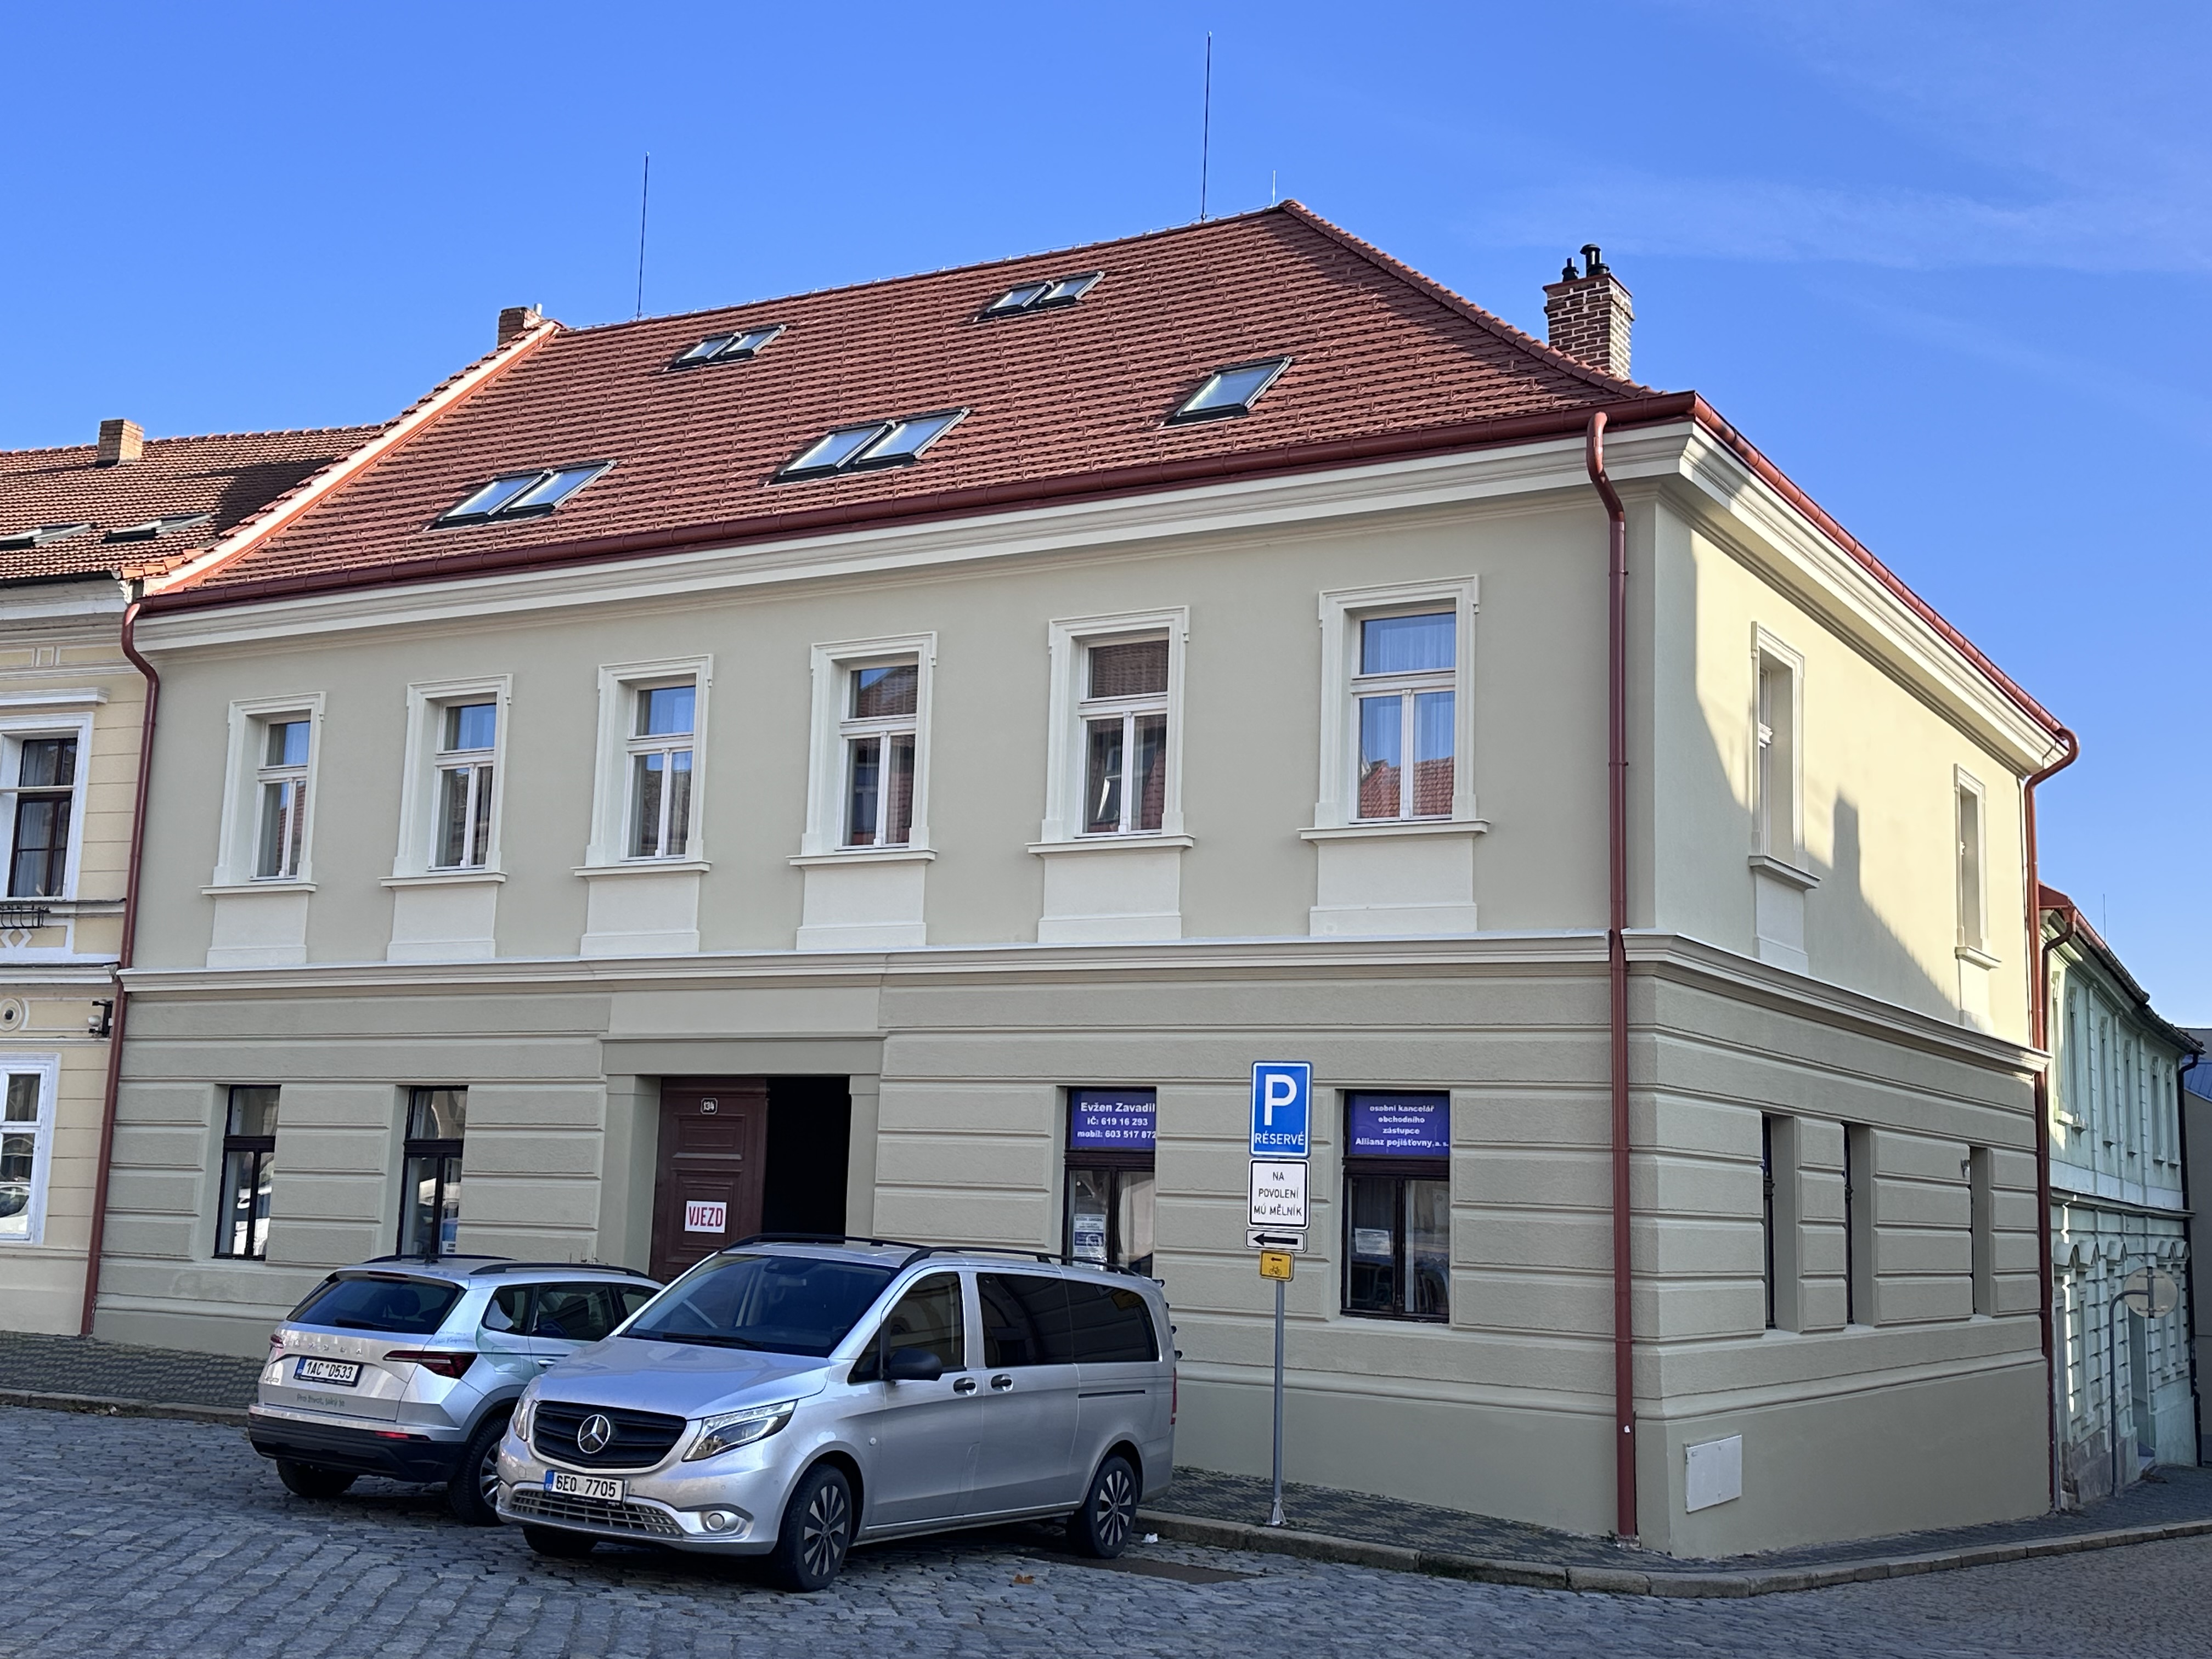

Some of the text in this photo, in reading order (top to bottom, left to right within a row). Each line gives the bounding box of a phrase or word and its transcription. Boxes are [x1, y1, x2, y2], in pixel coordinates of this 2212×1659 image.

[1265, 1074, 1297, 1126] P
[1081, 1102, 1155, 1113] Evžen Zavadil
[1087, 1116, 1098, 1125] IČ:
[1077, 1130, 1103, 1138] mobil:
[1255, 1130, 1305, 1146] RÉSERVÉ
[1383, 1127, 1420, 1136] zástupce
[1272, 1172, 1284, 1181] NA
[1259, 1187, 1299, 1199] POVOLENÍ
[689, 1206, 723, 1227] VJEZD
[1254, 1203, 1302, 1217] MÚ MĚLNÍK
[307, 1361, 324, 1376] 1AC
[585, 1479, 617, 1498] 7705
